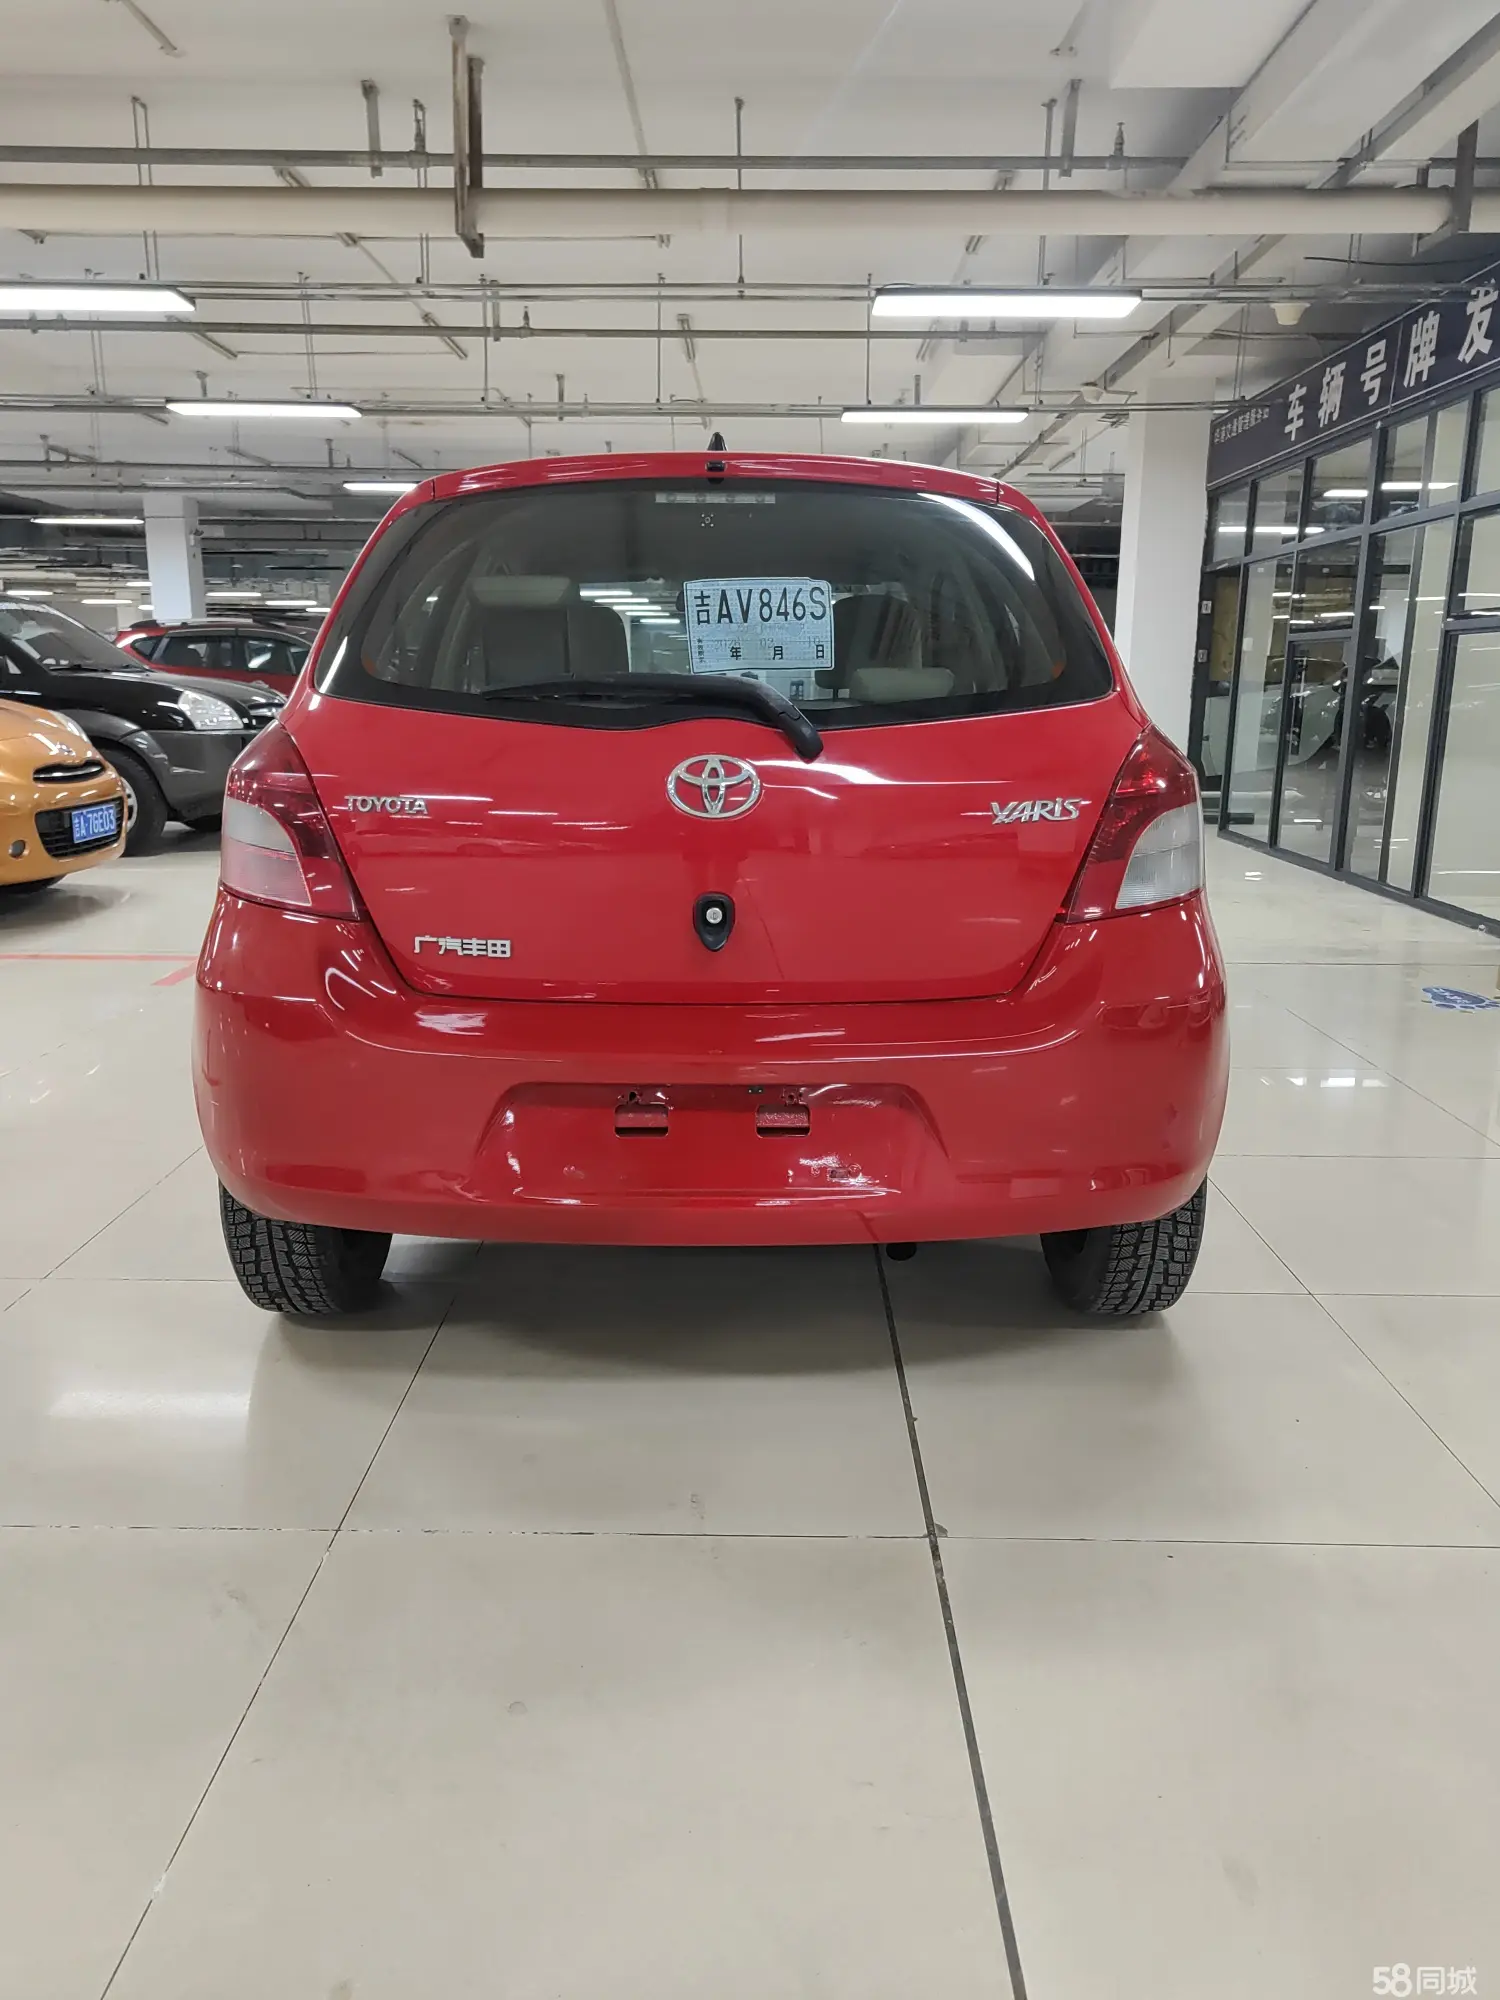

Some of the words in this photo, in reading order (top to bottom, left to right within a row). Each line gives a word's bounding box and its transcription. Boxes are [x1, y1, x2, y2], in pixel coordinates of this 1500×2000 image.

[694, 587, 827, 625] 吉AV846S
[730, 646, 742, 660] 年
[772, 646, 784, 660] 月
[816, 644, 825, 659] 日
[344, 795, 428, 814] TOYOTA
[414, 935, 511, 957] 广汽丰田
